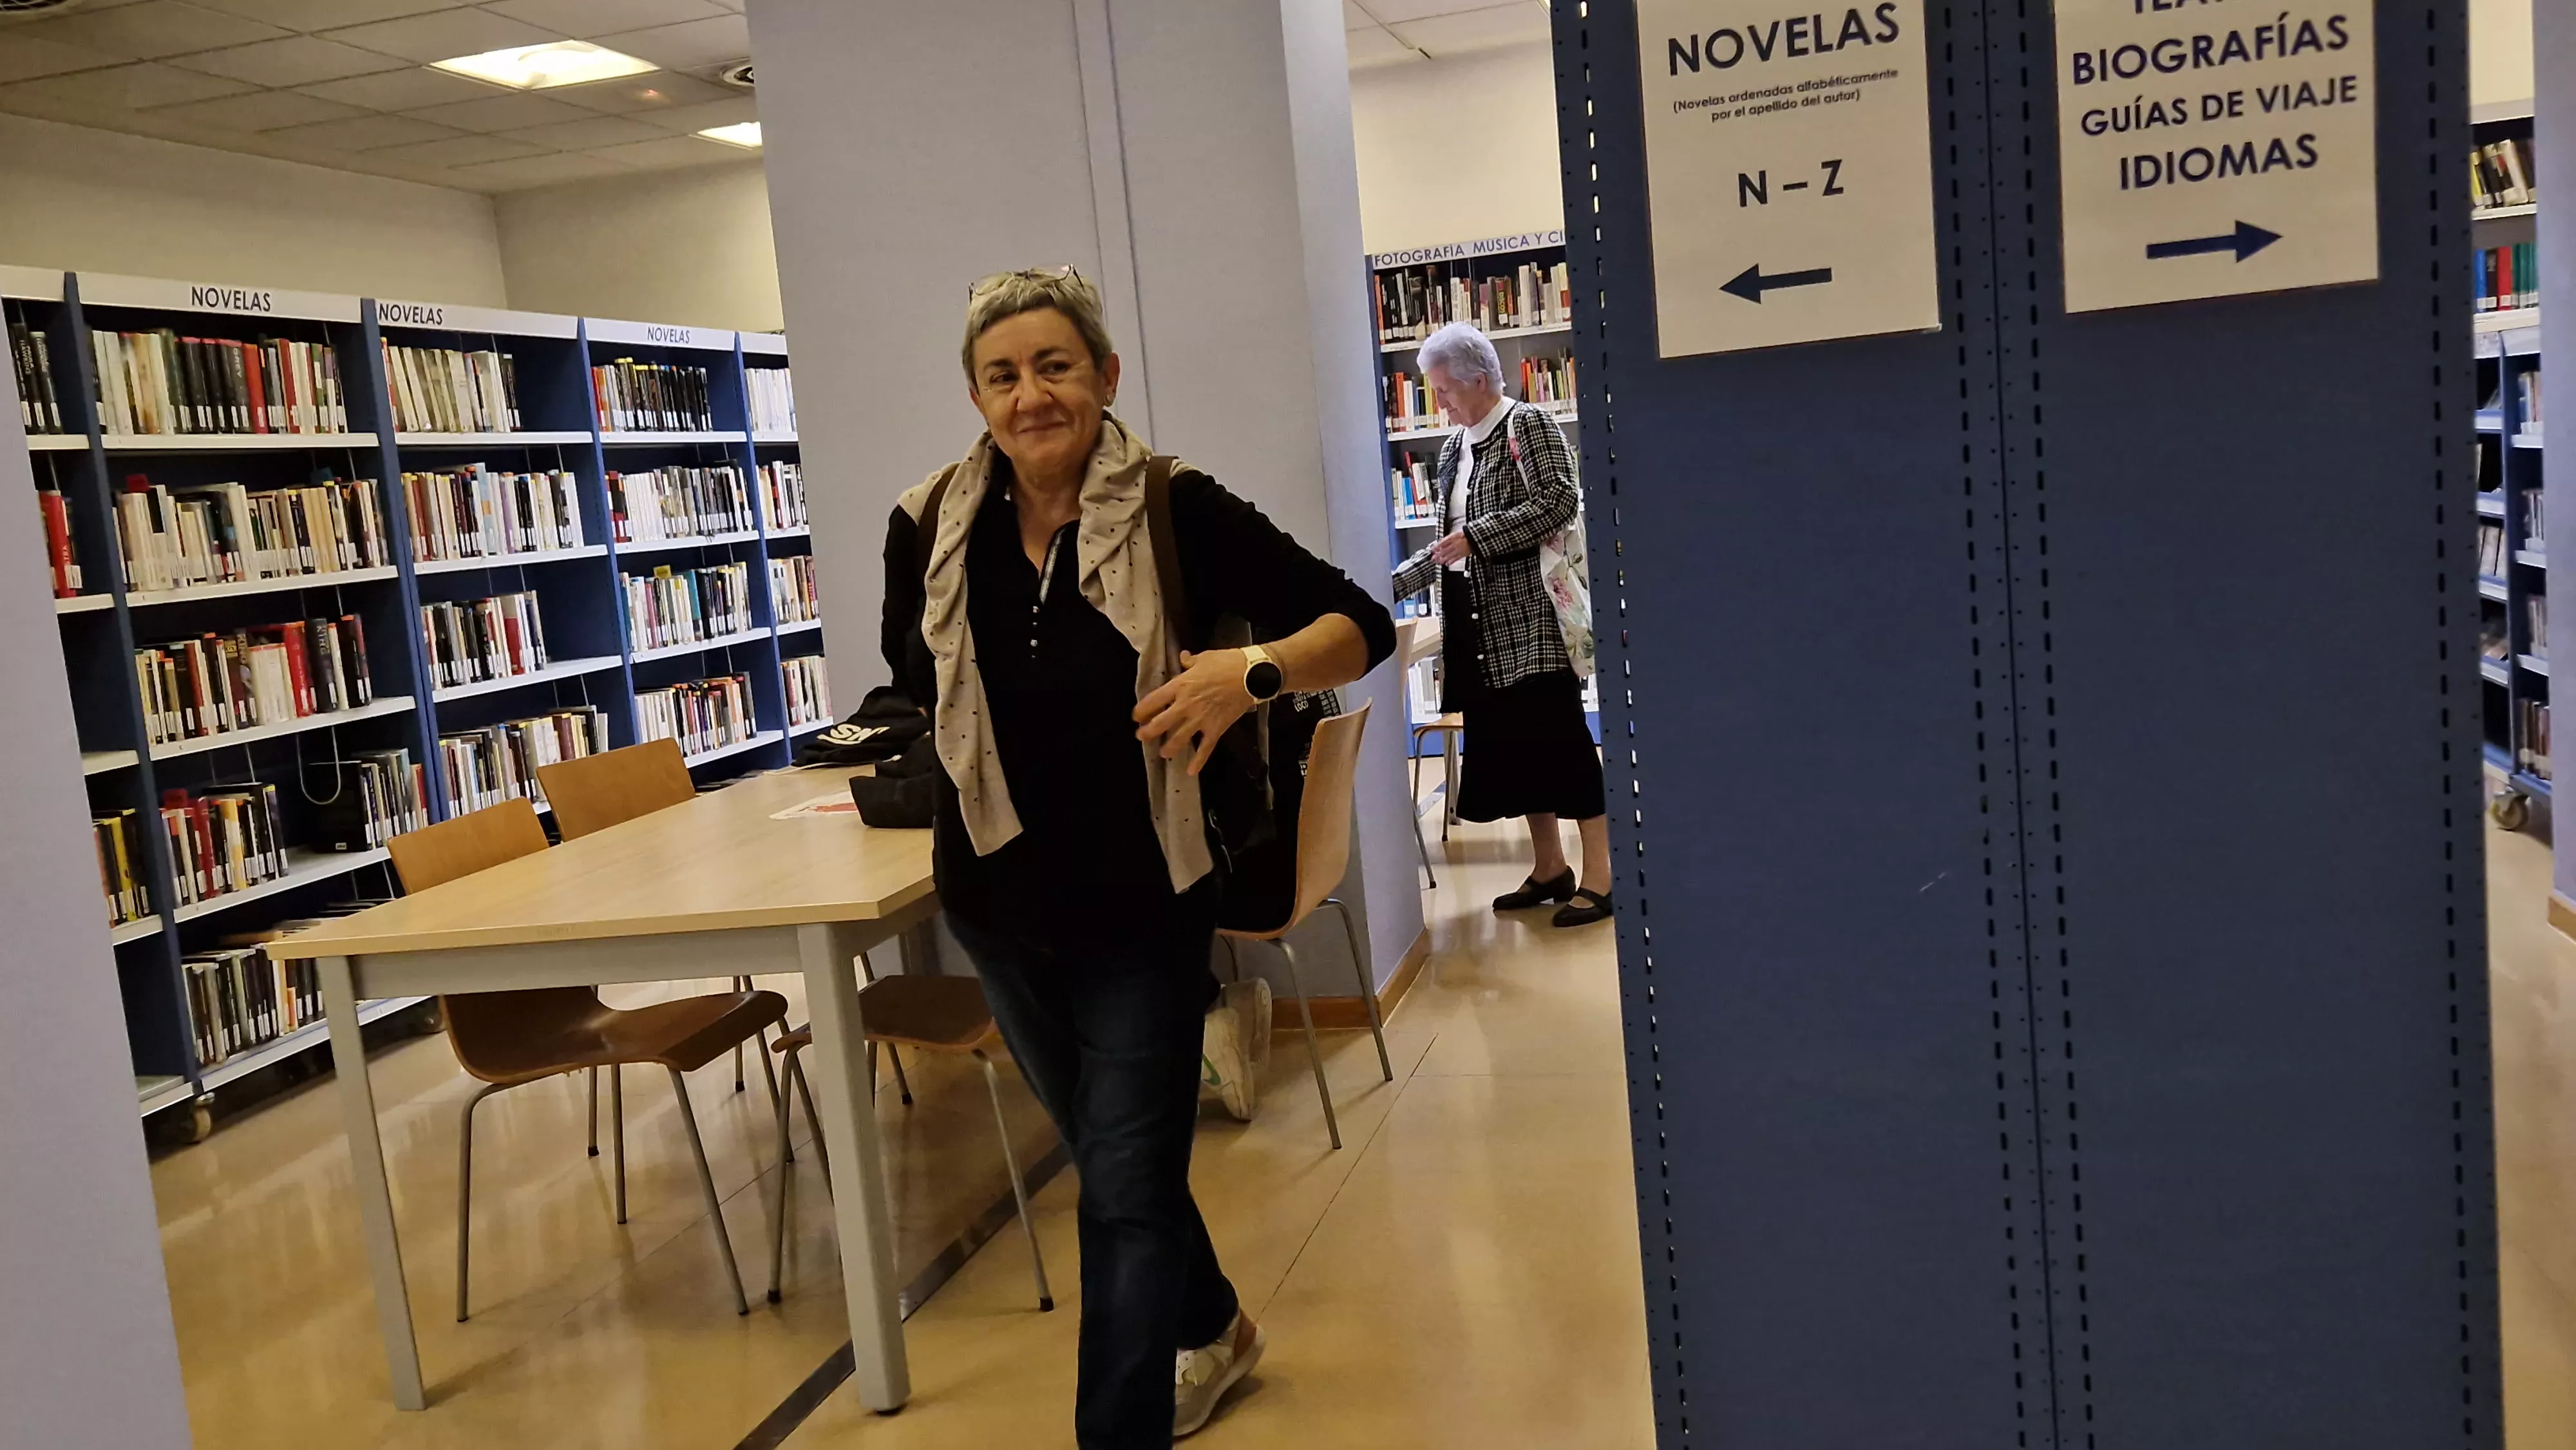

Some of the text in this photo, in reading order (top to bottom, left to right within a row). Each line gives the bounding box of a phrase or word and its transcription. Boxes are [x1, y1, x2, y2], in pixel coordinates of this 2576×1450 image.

[1668, 2, 1899, 77] NOVELAS
[2073, 12, 2349, 85] BIOGRAFÍAS
[1673, 69, 1899, 113] (Novelas ordenadas alfabéticamente
[1711, 89, 1861, 122] por el apellido del autor)
[2081, 76, 2356, 136] GUÍAS DE VIAJE
[1738, 170, 1768, 207] N
[1821, 159, 1844, 196] Z
[2120, 133, 2318, 190] IDIOMAS
[1534, 232, 1542, 245] Y
[191, 286, 271, 312] NOVELAS
[379, 303, 443, 326] NOVELAS
[647, 326, 690, 344] NOVELAS
